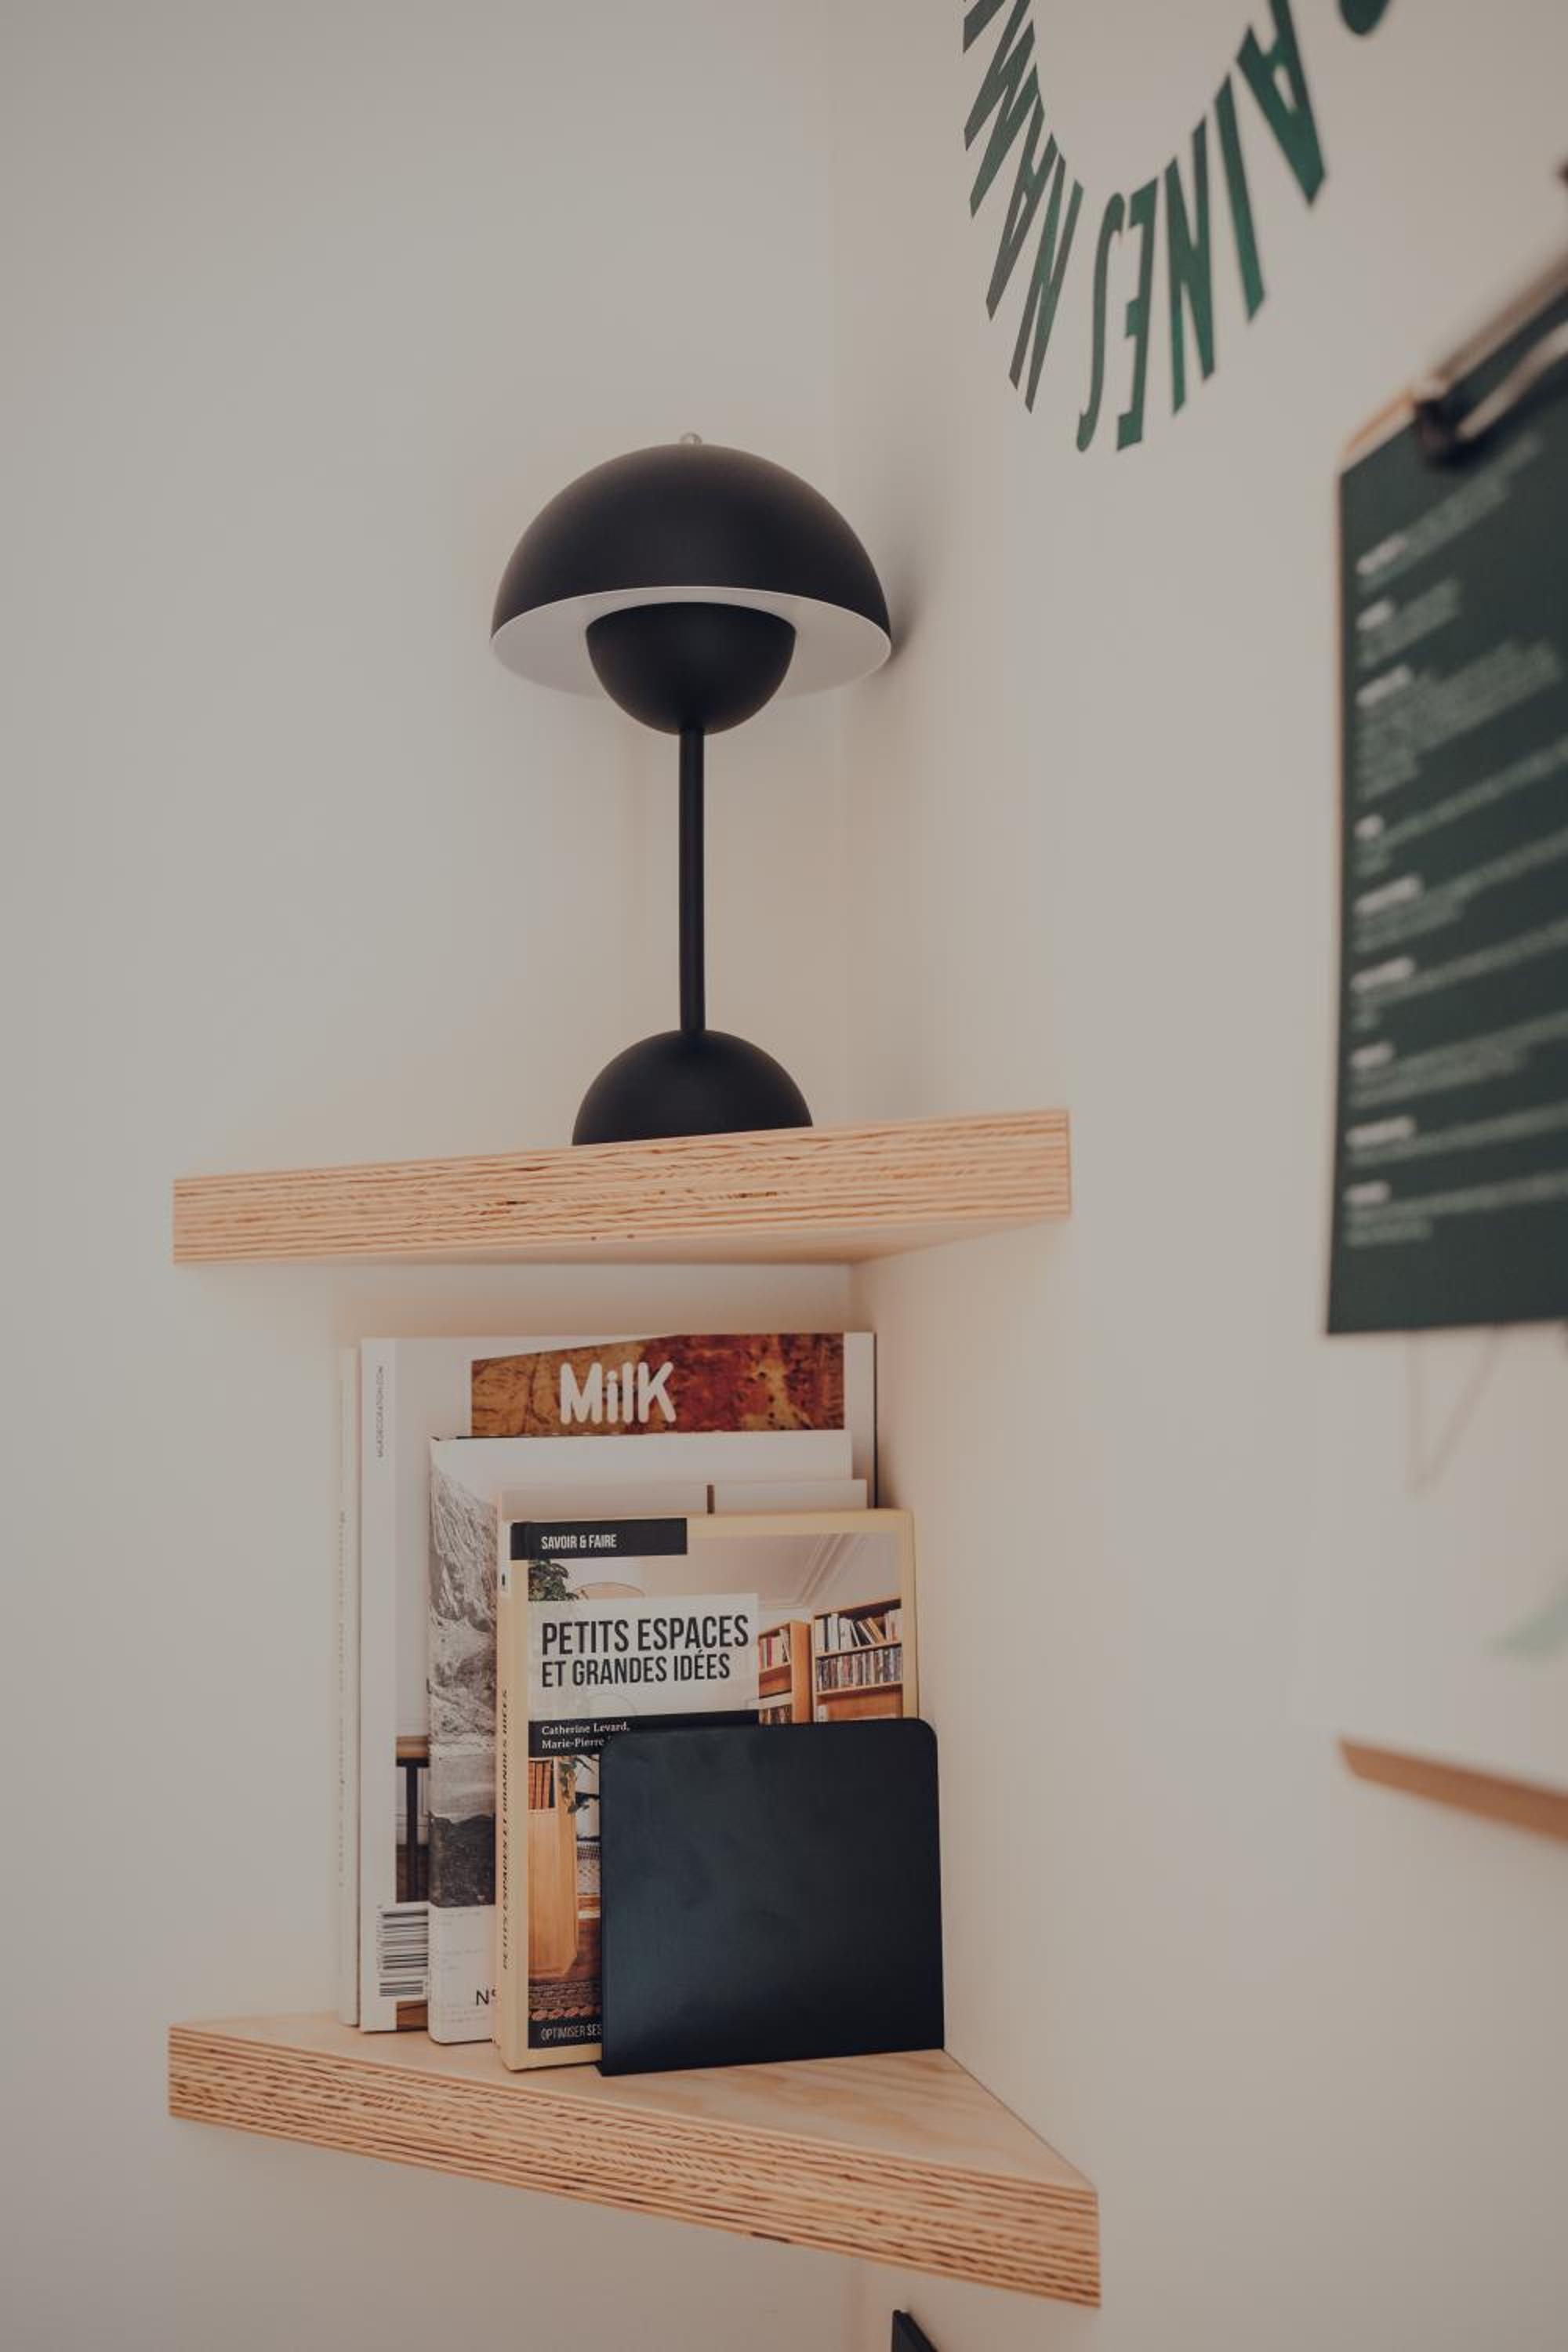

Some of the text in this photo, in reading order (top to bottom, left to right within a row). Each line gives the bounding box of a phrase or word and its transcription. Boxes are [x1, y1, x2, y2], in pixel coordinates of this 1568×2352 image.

[1076, 0, 1392, 452] AINES
[541, 1534, 617, 1550] SAVOIR & FAIRE
[541, 1614, 750, 1656] PETITS ESPACES
[541, 1649, 731, 1688] ET GRANDES IDÉES
[541, 1721, 631, 1736] Catherine Levard,
[541, 1737, 605, 1750] Marie-Pierre
[540, 2025, 586, 2042] OPTIMISER
